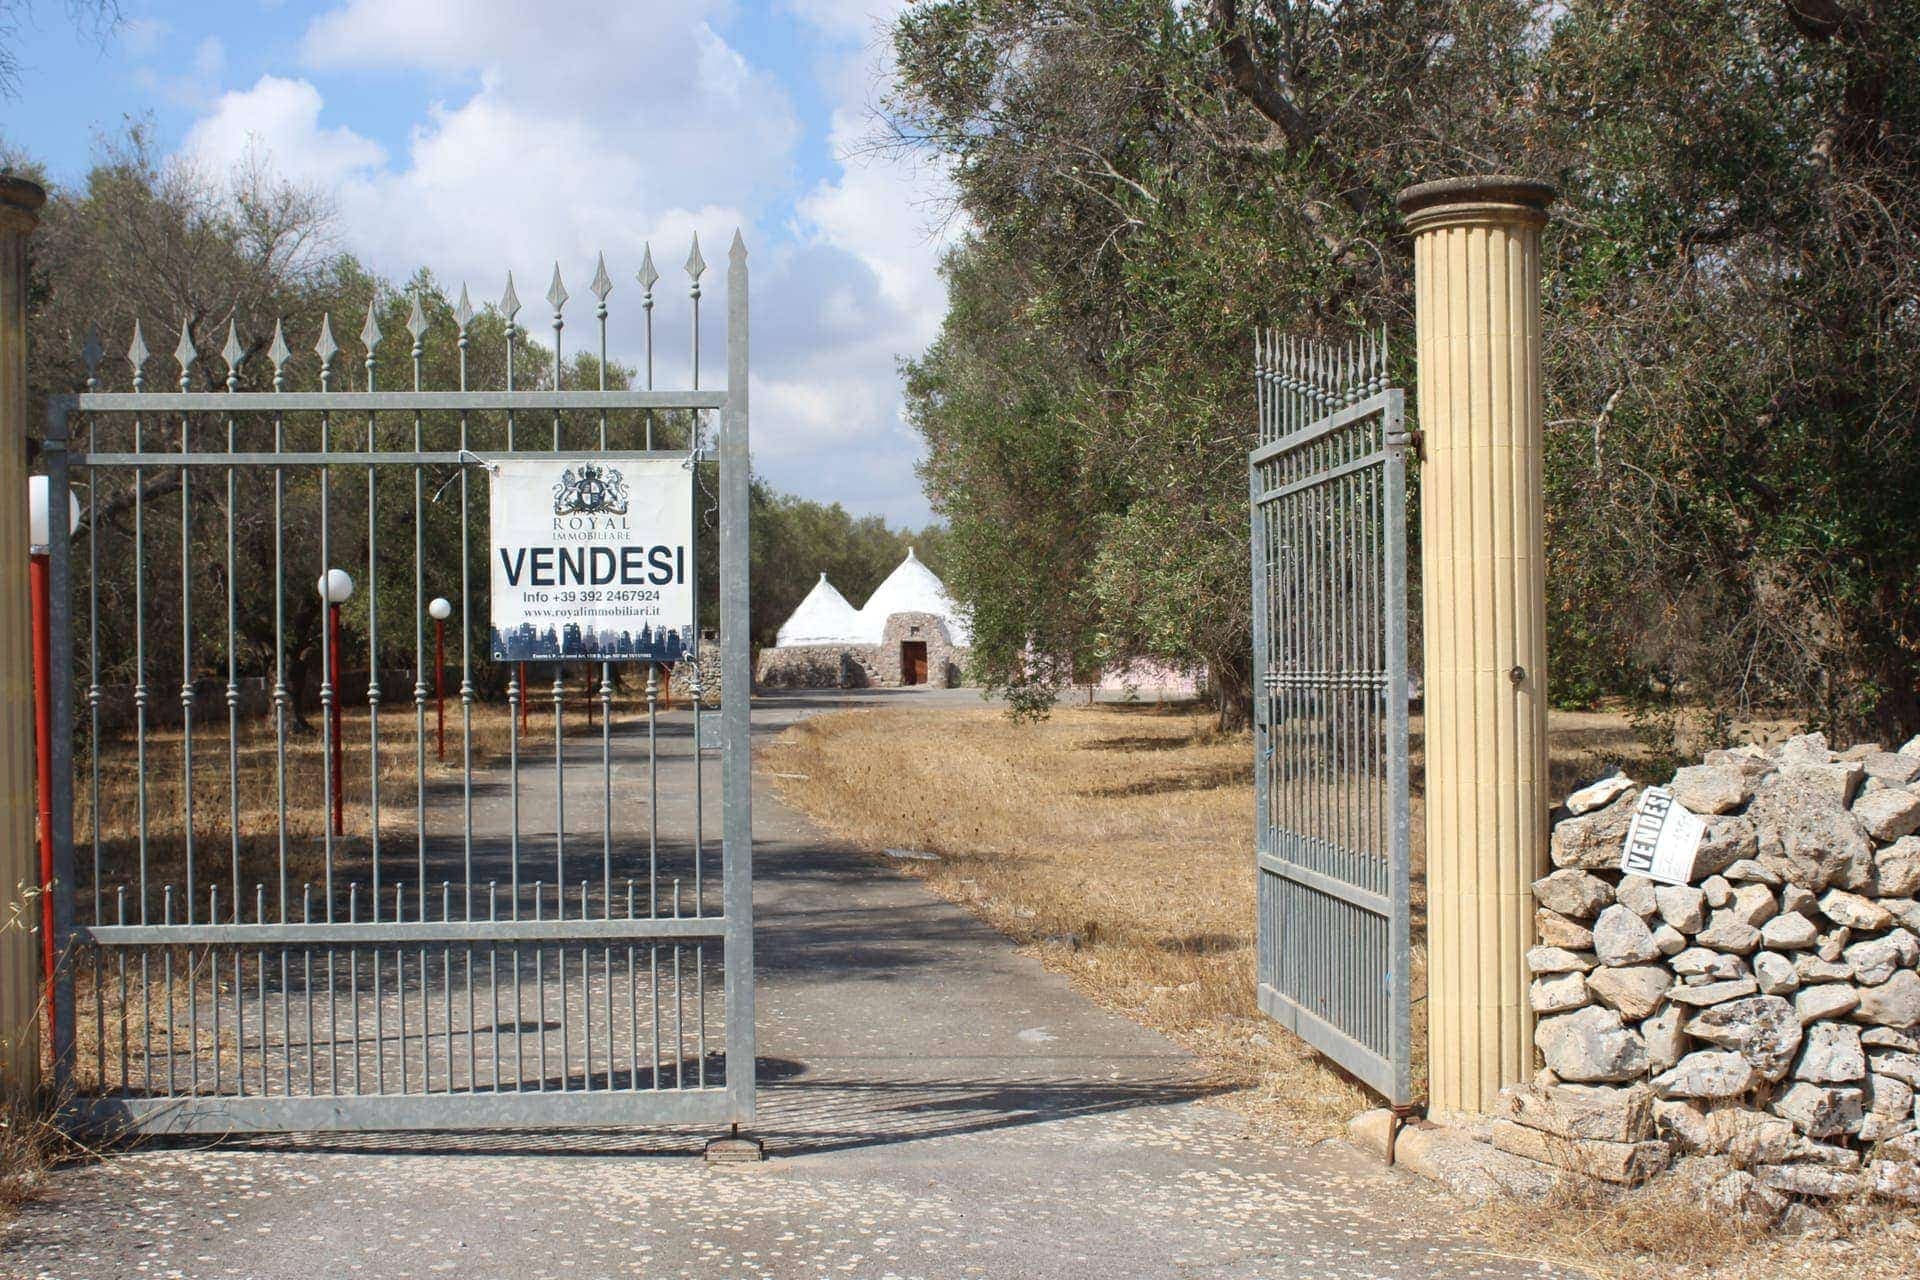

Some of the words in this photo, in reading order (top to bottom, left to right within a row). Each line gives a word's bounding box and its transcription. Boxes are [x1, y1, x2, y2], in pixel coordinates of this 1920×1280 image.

[553, 517, 630, 529] ROYAL
[553, 531, 630, 540] IMMOBILIARE
[500, 545, 684, 586] VENDESI
[523, 592, 549, 603] Info
[553, 591, 576, 602] +39
[580, 591, 602, 602] 392
[606, 590, 660, 601] 2467924
[524, 606, 660, 618] www.royalimmobiliari.it
[1628, 791, 1672, 871] VENDESI
